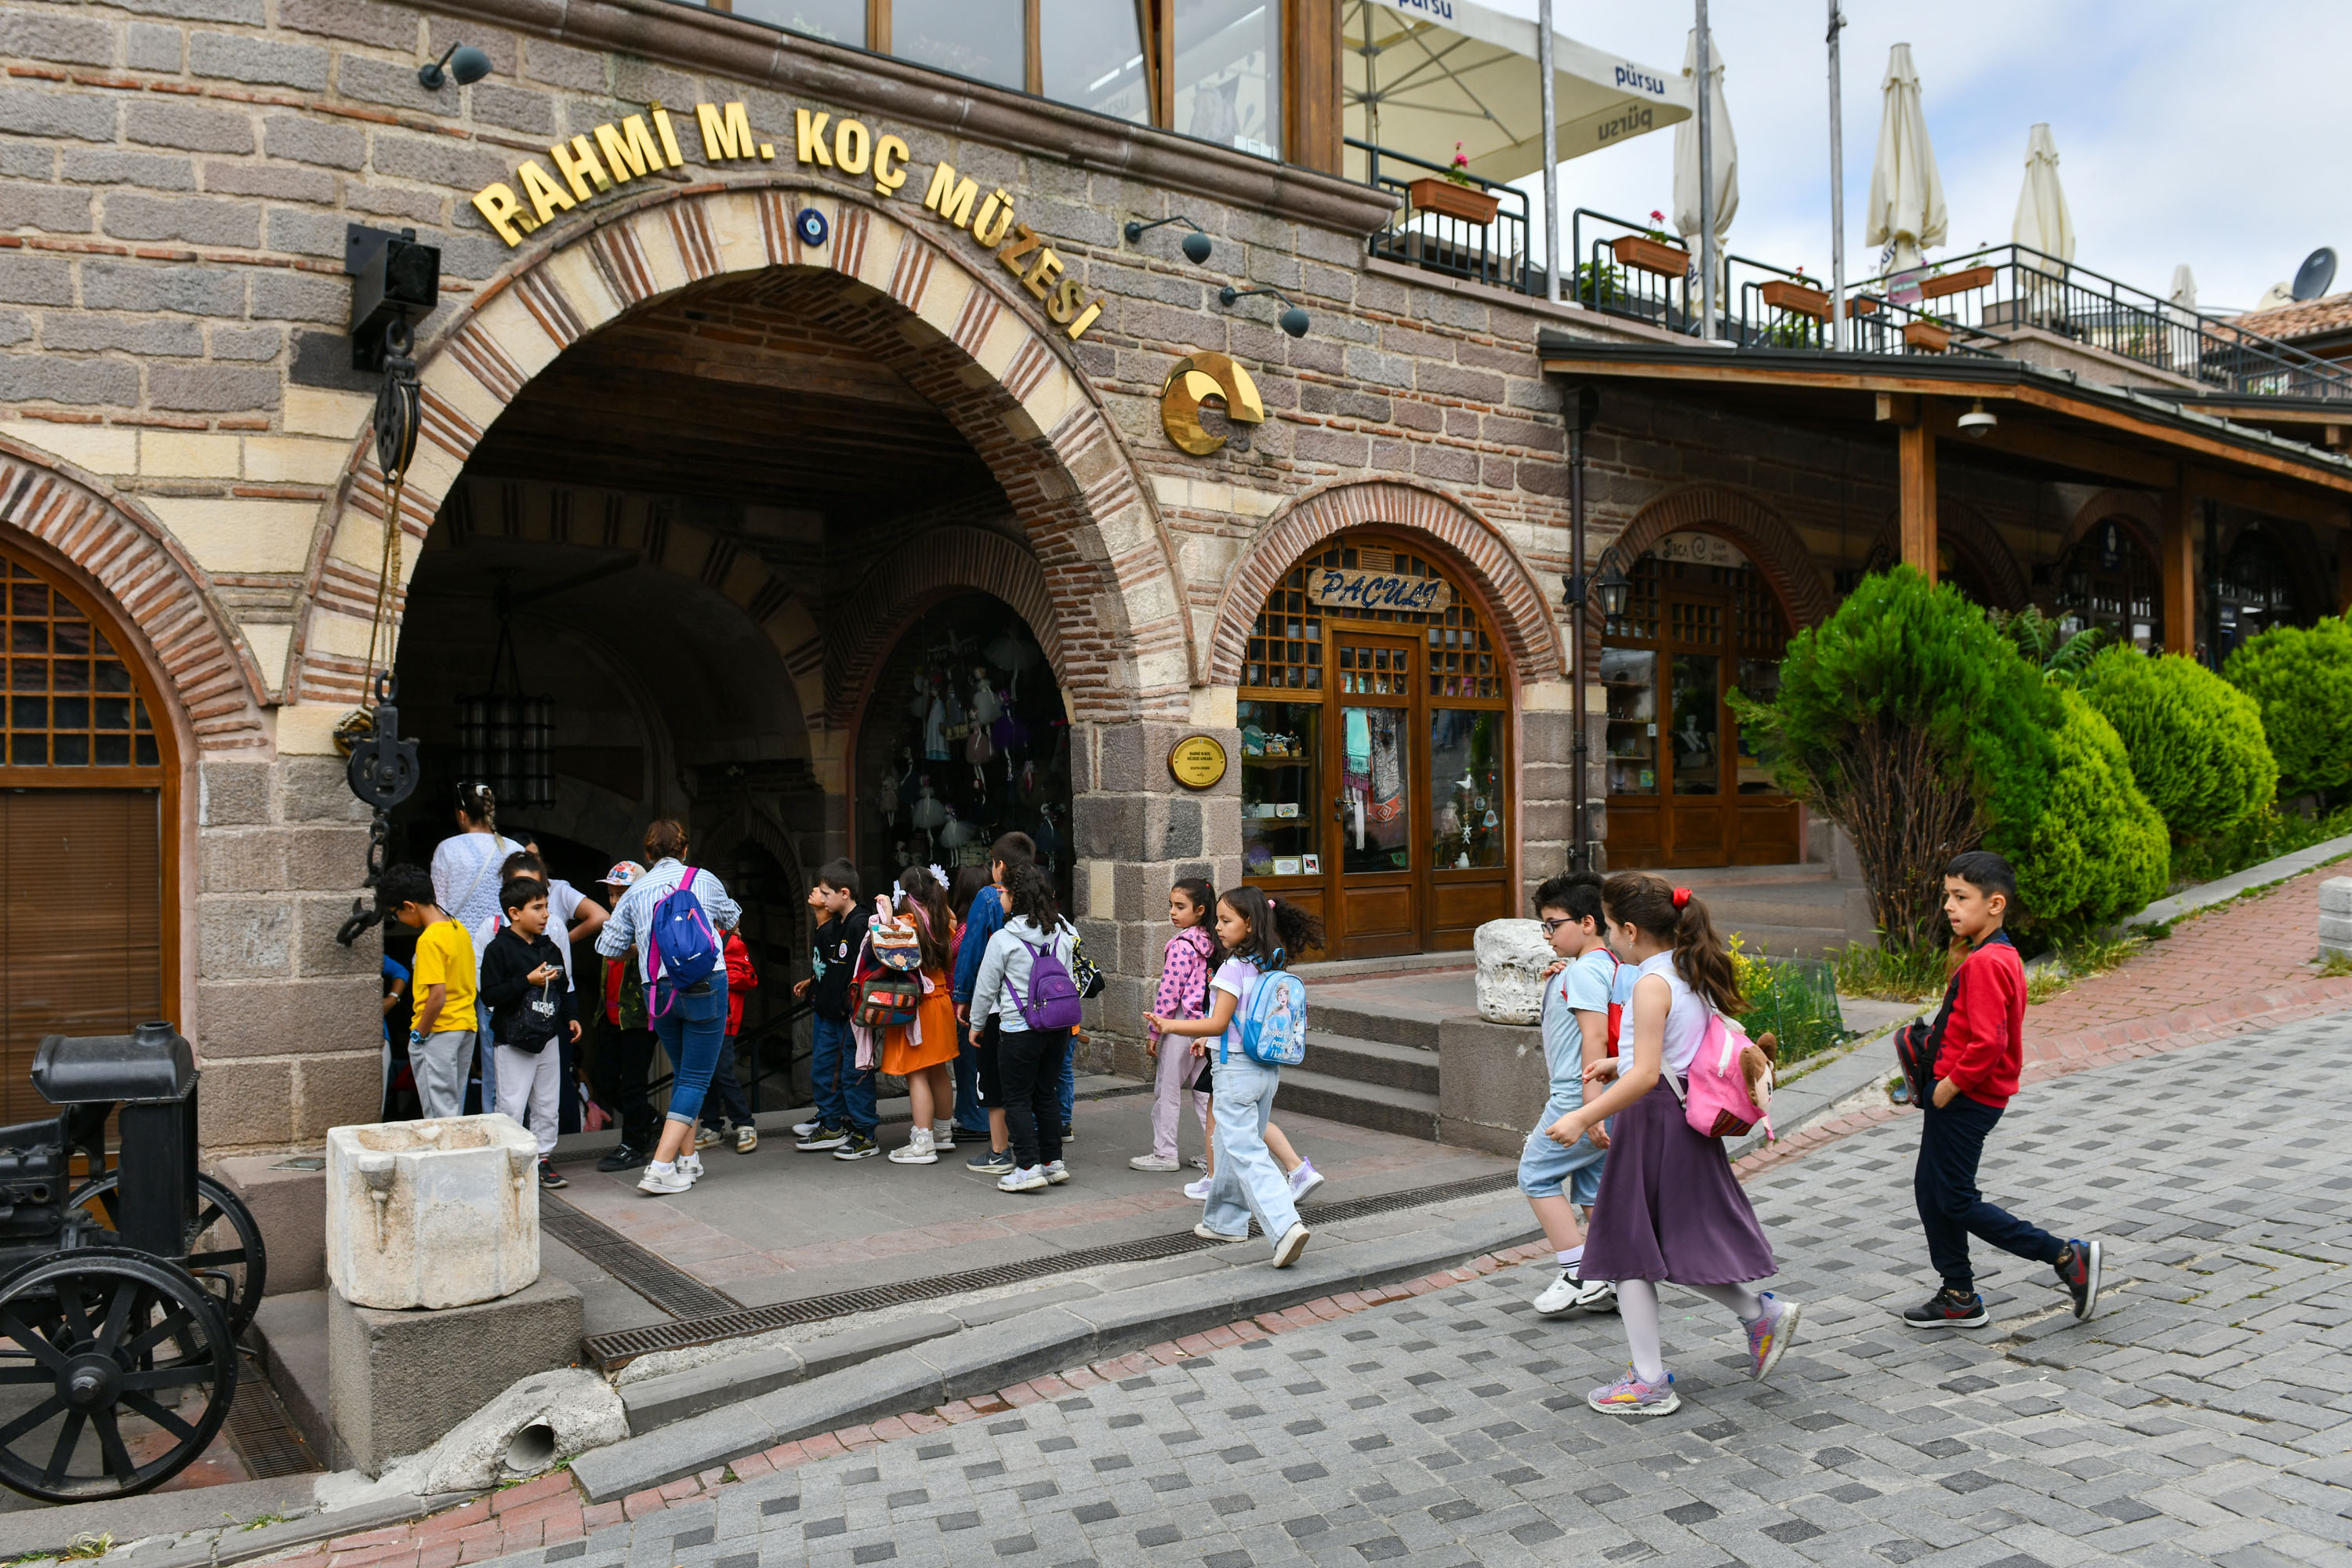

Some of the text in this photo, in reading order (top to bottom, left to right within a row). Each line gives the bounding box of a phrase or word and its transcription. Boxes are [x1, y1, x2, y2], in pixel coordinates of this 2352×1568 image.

[1615, 63, 1664, 94] pürsu
[471, 100, 1106, 341] RAHMİ M. KOÇ MÜZESİ
